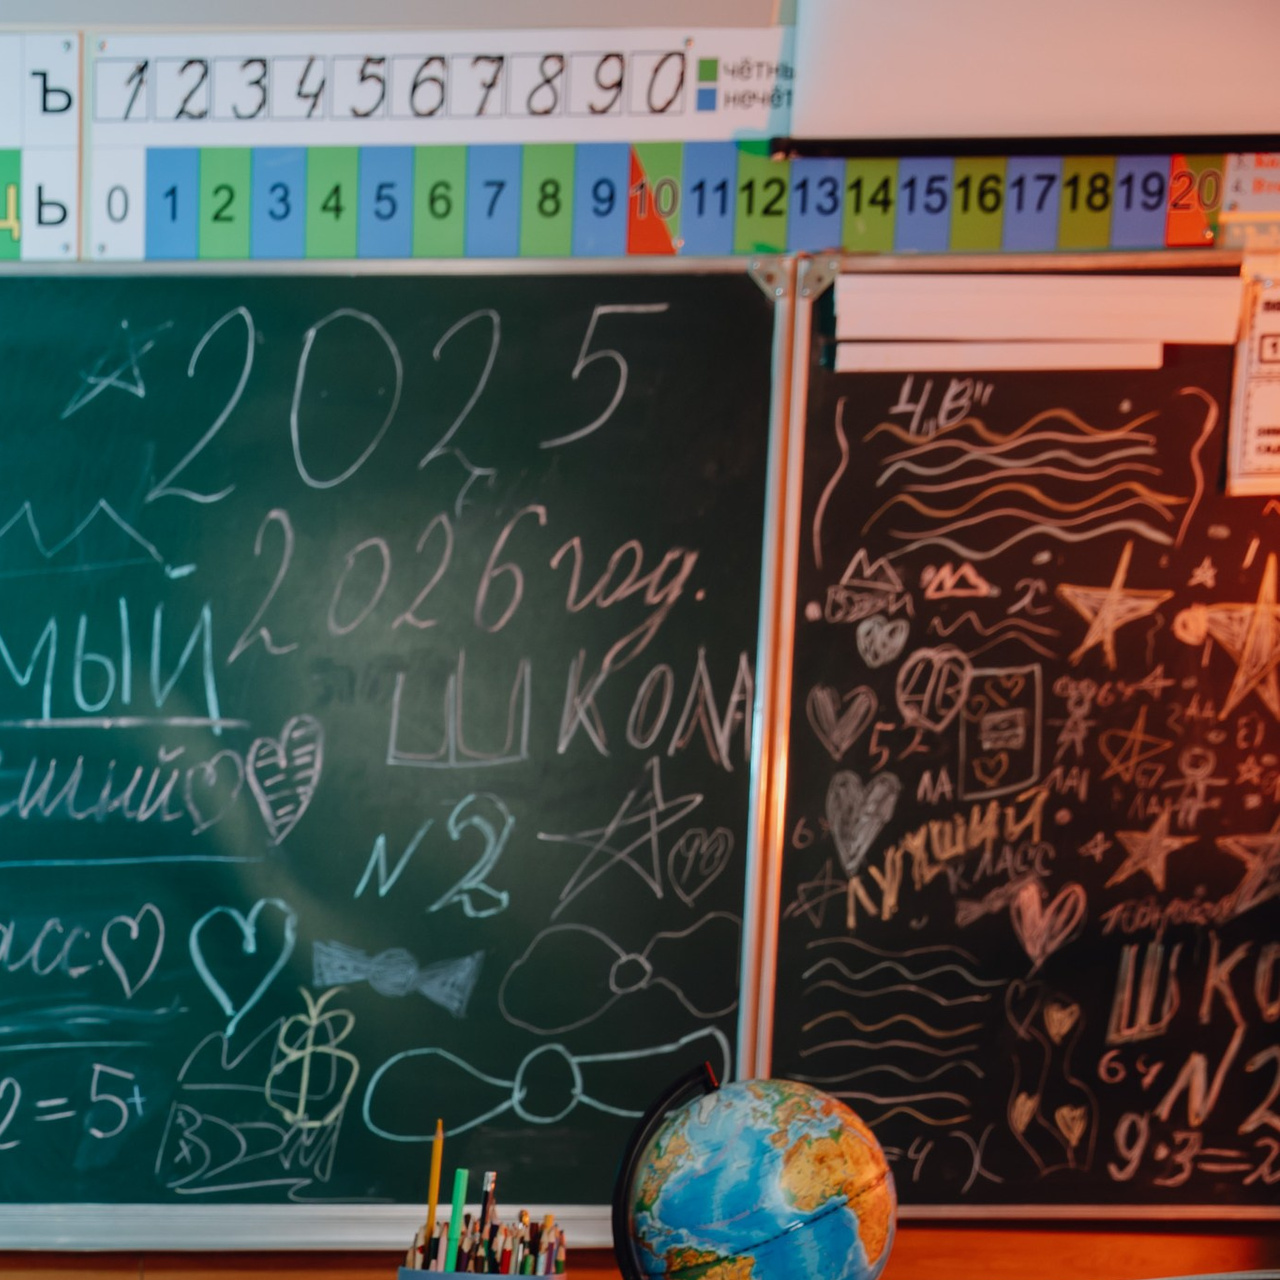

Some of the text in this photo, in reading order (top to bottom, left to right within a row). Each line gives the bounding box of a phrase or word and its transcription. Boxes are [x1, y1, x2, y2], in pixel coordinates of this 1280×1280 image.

[123, 52, 686, 120] 1 2 3 4 5 6 7 8 9 0
[106, 185, 128, 223] 0
[163, 185, 178, 221] 1
[211, 185, 236, 223] 2
[269, 184, 291, 221] 3
[322, 184, 344, 220] 4
[374, 183, 397, 220] 5
[429, 182, 452, 219] 6
[484, 180, 505, 217] 7
[538, 179, 561, 217] 8
[591, 178, 615, 216] 9
[632, 179, 679, 217] 10
[690, 178, 730, 216] 11
[740, 178, 787, 216] 12
[793, 177, 839, 215] 13
[848, 176, 894, 213] 14
[901, 175, 948, 213] 15
[956, 175, 1003, 212] 16
[1011, 174, 1057, 212] 17
[1065, 173, 1111, 211] 18
[1120, 172, 1166, 210] 19
[1172, 171, 1221, 210] 20
[144, 304, 670, 502] 2025
[228, 505, 546, 665] 2026
